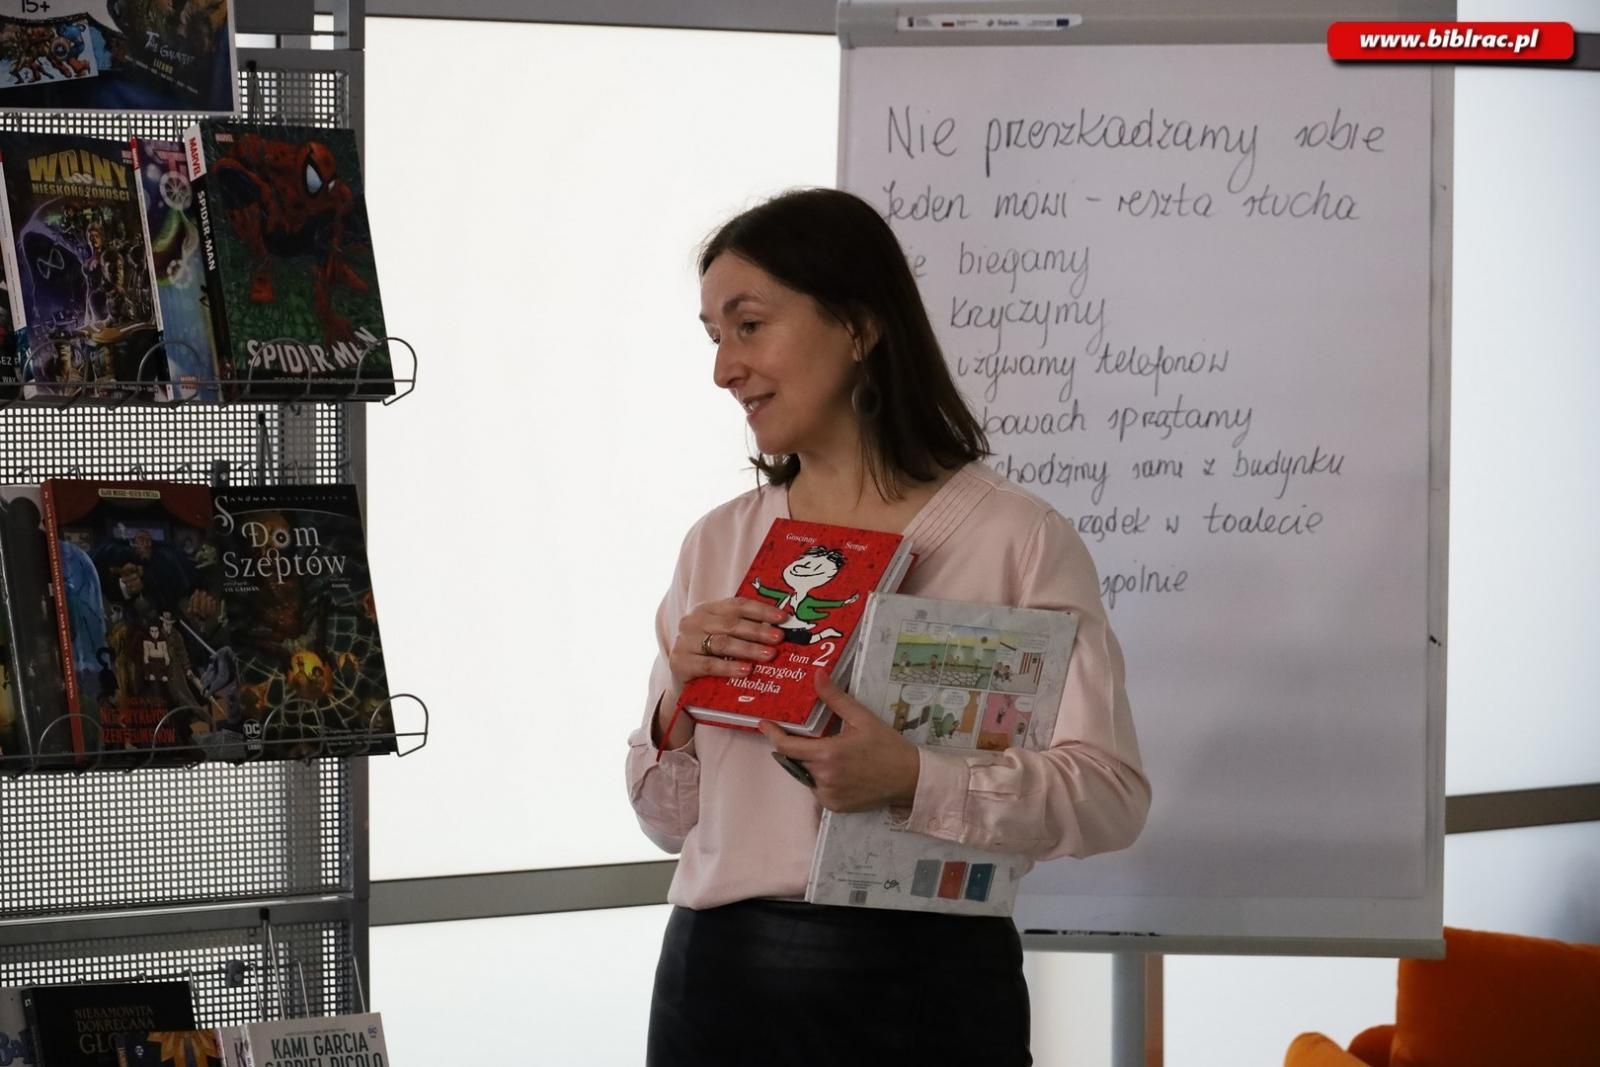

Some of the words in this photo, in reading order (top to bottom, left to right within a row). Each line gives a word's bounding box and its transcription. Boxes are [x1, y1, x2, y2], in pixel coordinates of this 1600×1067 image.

[27, 149, 128, 189] WOJNY
[189, 137, 202, 177] MARVEL
[888, 105, 958, 159] Nie
[985, 107, 1258, 194] przeszkadzamy
[1294, 107, 1386, 153] sobie
[883, 180, 971, 226] Jeden
[1117, 182, 1216, 219] reszta
[197, 190, 217, 271] SPIDER-MAN
[957, 241, 1091, 298] biegamy
[1107, 393, 1253, 448] sprzątamy
[1131, 456, 1186, 480] sami
[1232, 446, 1345, 499] budynku
[241, 521, 322, 548] Dom
[1165, 513, 1180, 534] w
[1203, 502, 1325, 535] toalecie
[222, 548, 347, 585] Szeptów
[753, 664, 807, 682] przygody
[789, 653, 810, 664] tom
[811, 641, 836, 667] 2
[244, 722, 261, 735] DC
[271, 1036, 309, 1060] KAMI
[313, 1031, 370, 1056] GARCIA
